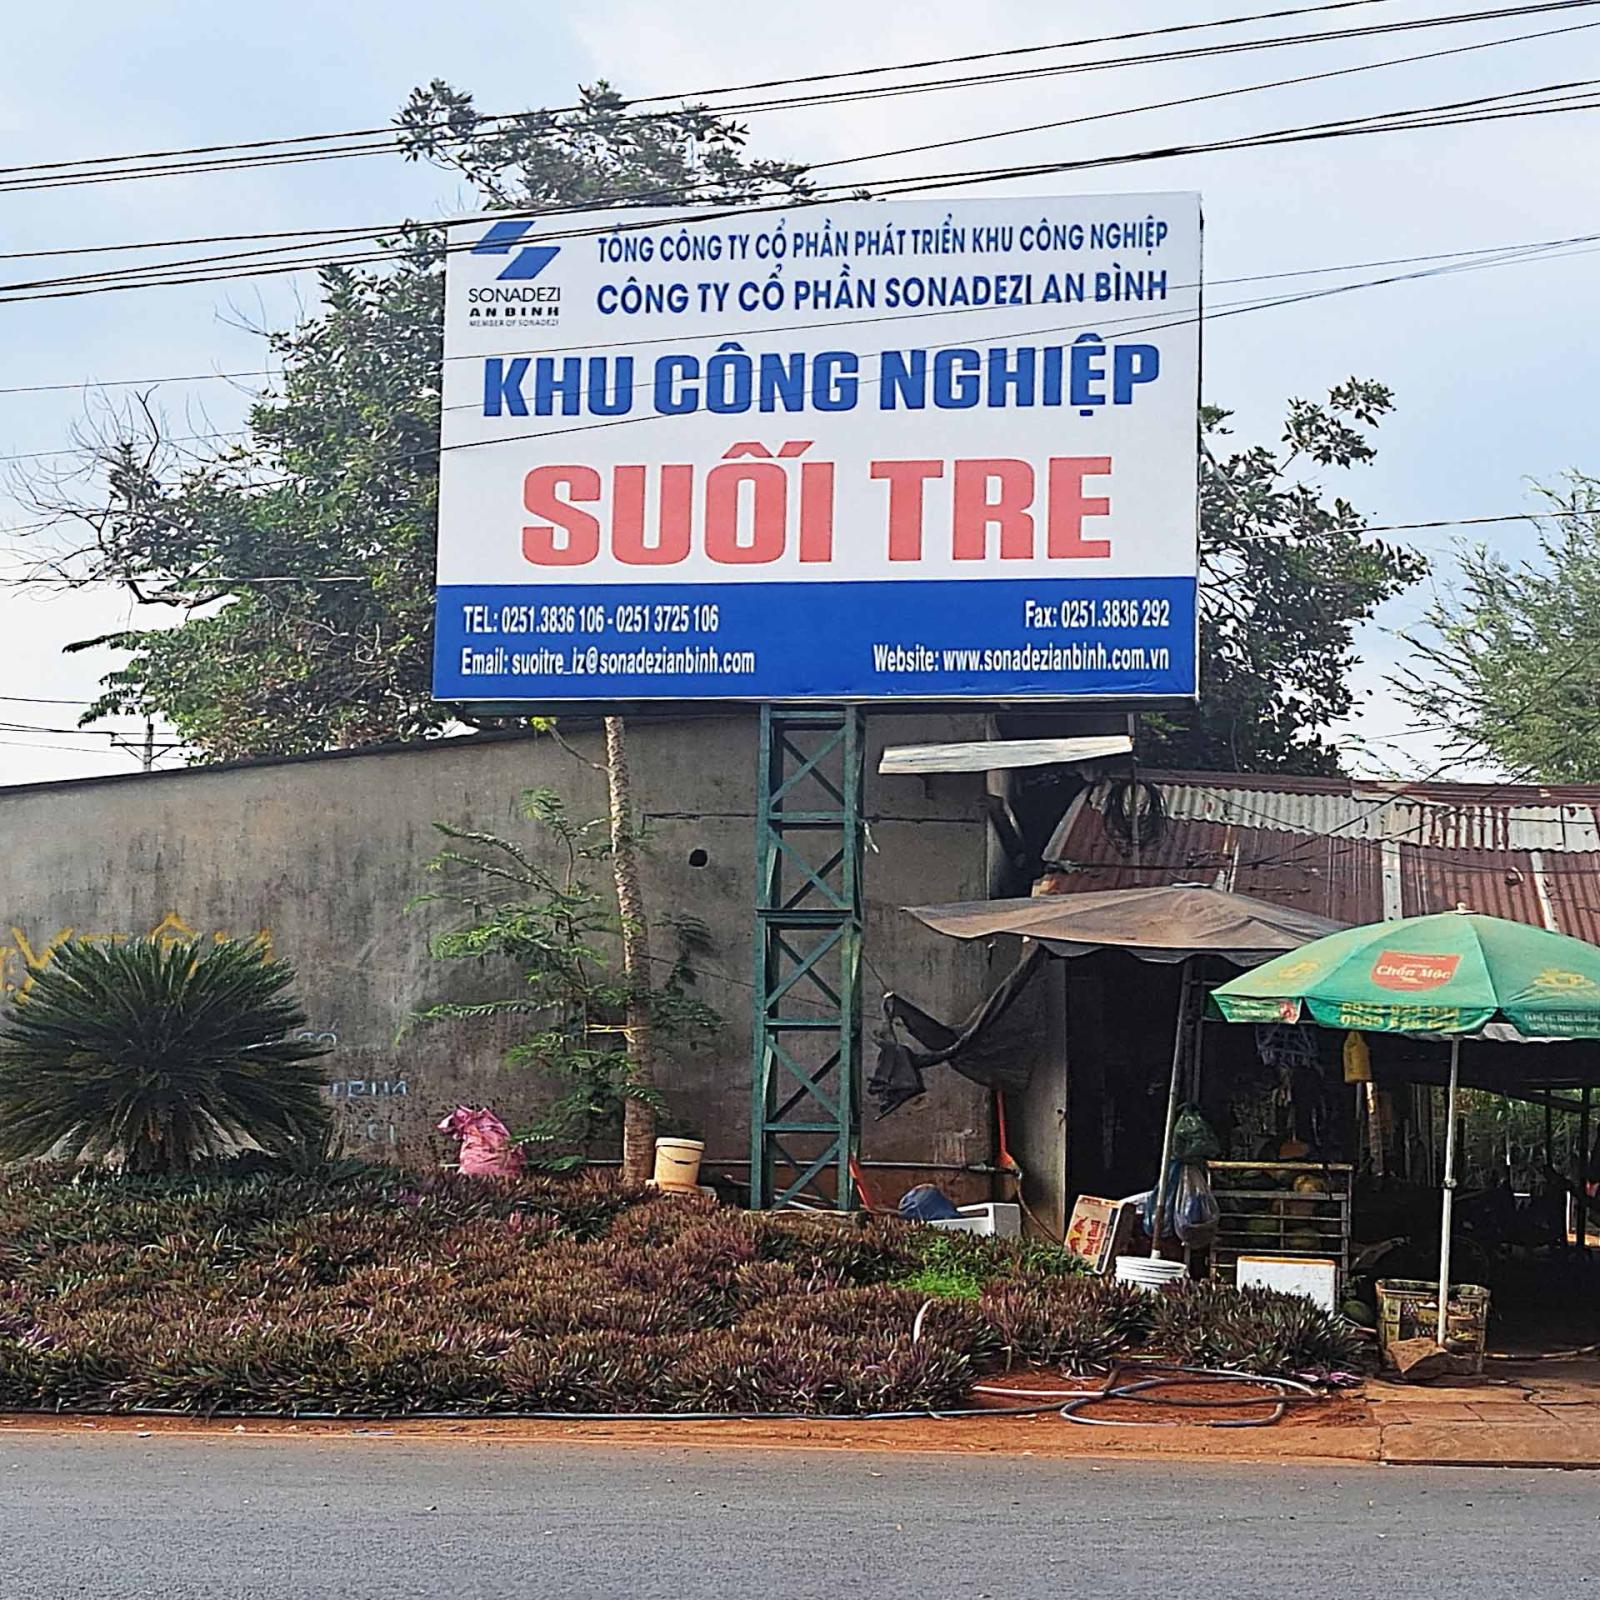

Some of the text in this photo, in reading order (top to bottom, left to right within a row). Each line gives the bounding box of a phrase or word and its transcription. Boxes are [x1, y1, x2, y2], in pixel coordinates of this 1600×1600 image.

[660, 228, 722, 262] CÔNG
[728, 234, 750, 260] TY
[755, 217, 786, 259] CỔ
[793, 218, 849, 258] PHẦN
[855, 222, 906, 256] PHÁT
[911, 213, 966, 254] TRIỂN
[972, 226, 1013, 253] KHU
[1019, 217, 1084, 251] CÔNG
[1090, 214, 1168, 256] NGHIỆP
[468, 287, 561, 303] SONADEZI
[598, 262, 1167, 315] CÔNG TY CỔ PHẦN SONADEZI AN BÌNH
[469, 306, 497, 317] AN
[483, 332, 1160, 417] KHU CÔNG NGHIỆP
[521, 440, 1112, 567] SUỐI TRE
[463, 605, 498, 633] TEL:
[501, 605, 575, 633] 0251.3836
[579, 605, 604, 633] 106
[616, 605, 650, 633] 0251
[654, 605, 689, 632] 3725
[693, 604, 718, 632] 106
[1025, 600, 1170, 628] Fax: 0251.3836 292
[461, 646, 755, 675] Email: suoitre_iz@sonadezianbinh.com
[873, 642, 1170, 672] Website: www.sonadezianbinh.com.vn
